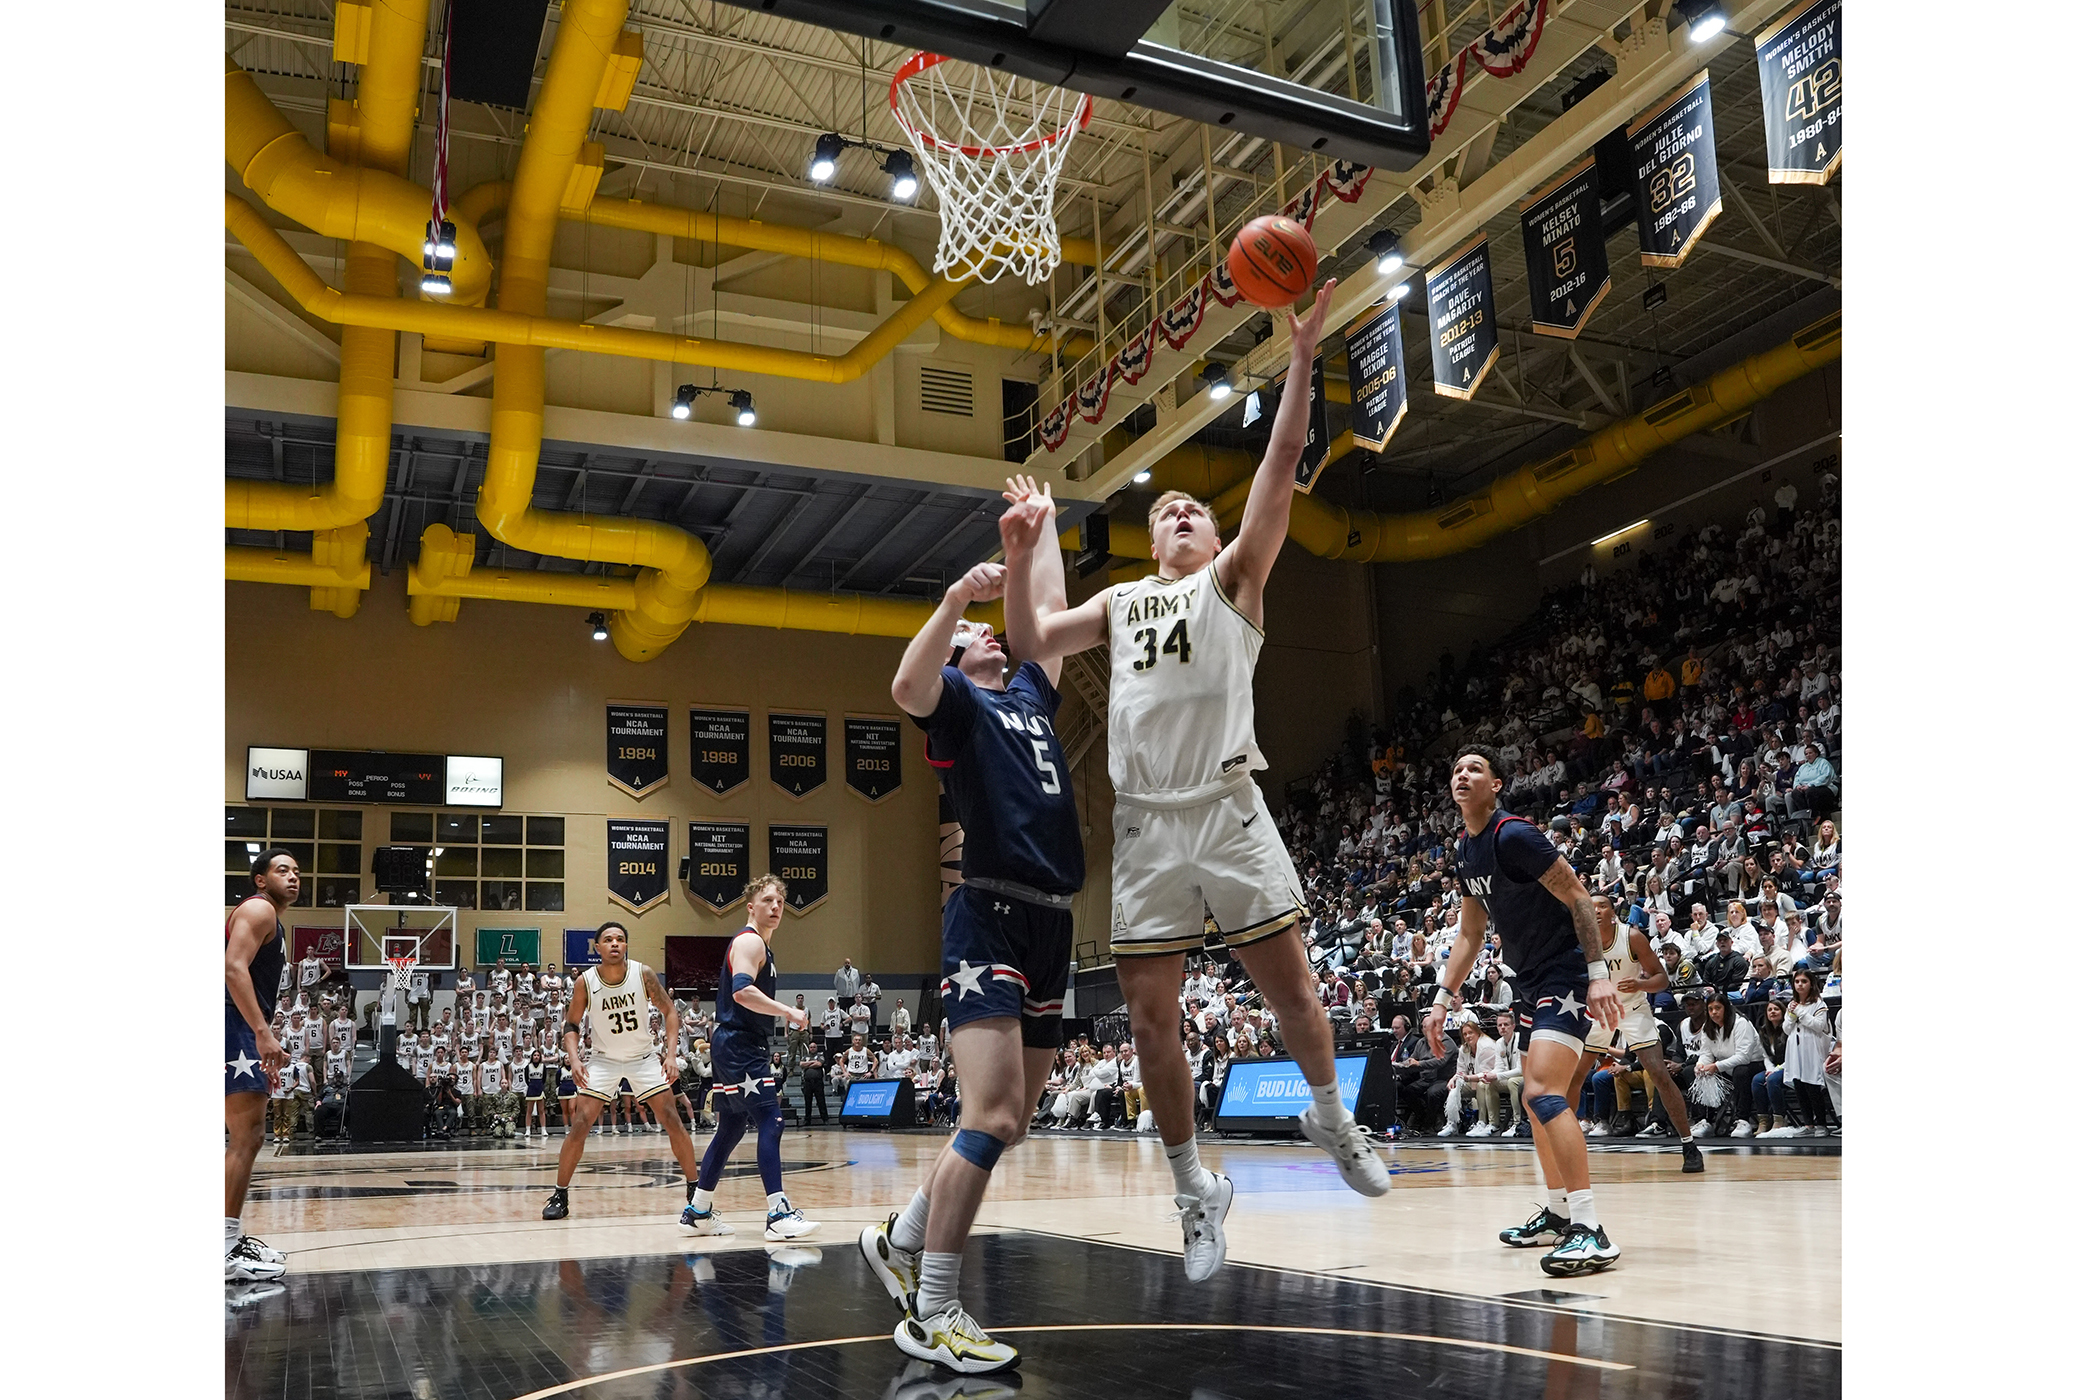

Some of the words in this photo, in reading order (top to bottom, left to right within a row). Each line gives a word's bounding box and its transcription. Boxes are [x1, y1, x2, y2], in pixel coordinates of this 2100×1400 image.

[1765, 30, 1800, 61] WOMEN'S
[1801, 0, 1842, 35] BASKETBA
[1782, 20, 1835, 69] MELODY
[1787, 38, 1834, 80] SMITH
[1785, 57, 1842, 122] 42
[1634, 128, 1662, 151] WOMEN'S
[1663, 96, 1704, 130] BASKETBALL
[1654, 124, 1684, 155] JULIE
[1638, 158, 1657, 180] DEL
[1659, 124, 1703, 163] GIORNO
[1649, 152, 1696, 214] 32
[1528, 206, 1554, 227] WOMEN'S
[1554, 182, 1589, 210] BASKETBALL
[1654, 195, 1696, 234] 1982-86
[1542, 202, 1578, 234] KELSEY
[1542, 214, 1580, 248] MINATO
[1553, 236, 1576, 278] 5
[1431, 275, 1453, 296] WOMEN'S
[1454, 254, 1483, 280] BASKETBALL
[1432, 288, 1450, 304] COACH
[1450, 283, 1458, 292] OF
[1458, 276, 1469, 286] THE
[1469, 264, 1484, 279] YEAR
[1550, 272, 1586, 302] 2012-16
[1448, 288, 1470, 310] DAVE
[1438, 291, 1482, 330] MAGARITY
[1350, 333, 1369, 352] WOMEN'S
[1369, 316, 1395, 338] BASKETBALL
[1440, 310, 1483, 348] 2012-13
[1350, 344, 1366, 360] COACH
[1372, 334, 1382, 346] THE
[1382, 324, 1395, 338] YEAR
[1449, 333, 1476, 356] PATRIOT
[1360, 342, 1388, 370] MAGGIE
[1452, 344, 1476, 364] LEAGUE
[1363, 355, 1386, 379] DIXON
[1356, 366, 1396, 403] 2005-06
[1366, 389, 1388, 410] PATRIOT
[1368, 401, 1387, 417] LEAGUE
[1654, 523, 1674, 540] 202
[1613, 542, 1631, 558] 201
[1127, 589, 1195, 626] ARMY
[1133, 618, 1191, 671] 34
[611, 727, 664, 736] TOURNAMENT
[626, 720, 648, 728] NCAA
[709, 724, 730, 732] NCAA
[787, 728, 808, 736] NCAA
[694, 731, 745, 740] TOURNAMENT
[773, 735, 822, 744] TOURNAMENT
[619, 747, 656, 760] 1984
[702, 750, 738, 764] 1988
[780, 754, 816, 767] 2006
[270, 769, 302, 780] USAA
[857, 758, 890, 771] 2013
[1030, 738, 1061, 796] 5
[450, 786, 498, 794] BOEING
[611, 841, 664, 850] TOURNAMENT
[626, 834, 649, 842] NCAA
[620, 862, 656, 875] 2014
[700, 863, 737, 876] 2015
[782, 867, 816, 879] 2016
[500, 934, 518, 954] L
[417, 978, 422, 986] 6
[602, 992, 635, 1011] ARMY
[608, 1010, 639, 1035] 35
[294, 1042, 299, 1050] 6
[341, 1033, 346, 1041] 6
[854, 1061, 860, 1069] 6
[463, 1076, 468, 1084] 6
[1257, 1081, 1285, 1098] BUD
[869, 1093, 884, 1104] LIGHT
